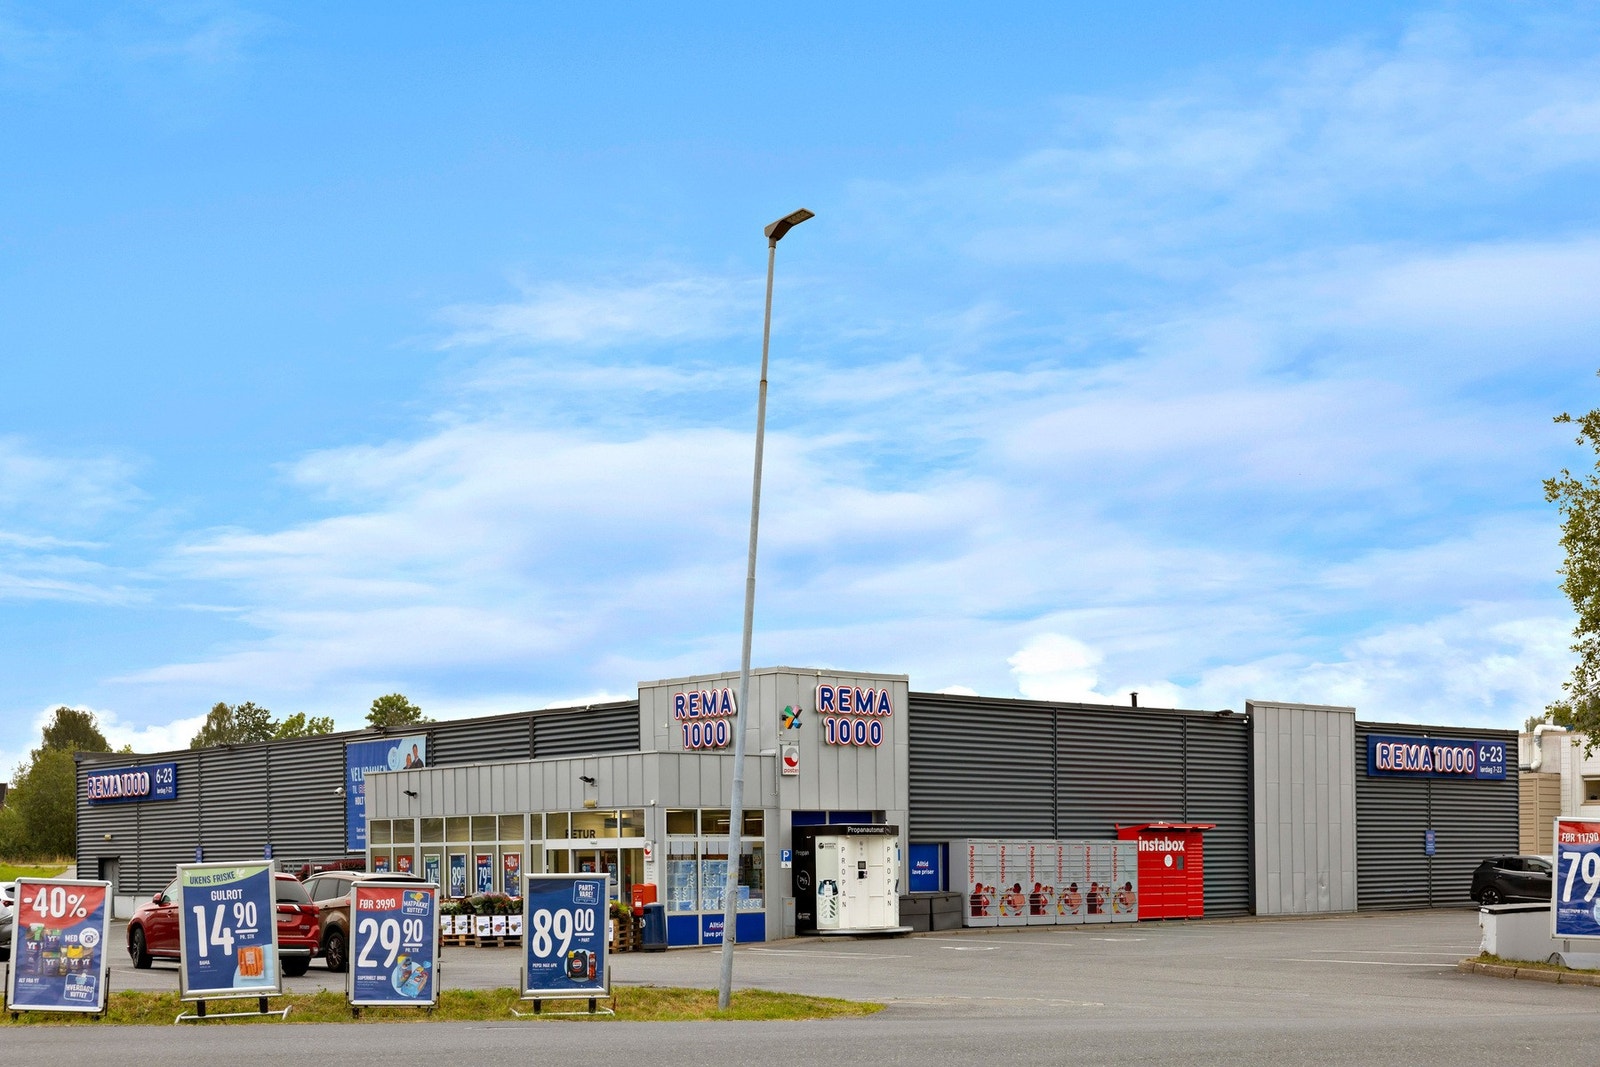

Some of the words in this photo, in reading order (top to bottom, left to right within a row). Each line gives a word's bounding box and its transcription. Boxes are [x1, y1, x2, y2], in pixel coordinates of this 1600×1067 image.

[674, 688, 735, 720] REMA
[817, 684, 893, 717] REMA
[682, 718, 730, 750] 1000
[824, 716, 884, 747] 1000
[1376, 742, 1433, 772] REMA
[1435, 745, 1475, 774] 1000
[1479, 746, 1503, 762] 6-23
[88, 775, 121, 799] REMA
[121, 772, 149, 796] 1000
[156, 768, 173, 783] 6-23
[848, 826, 885, 834] Propanautomat
[1561, 833, 1575, 842] FØR
[1577, 832, 1599, 843] 117,90
[1138, 836, 1185, 851] instabox
[783, 850, 790, 861] P
[190, 875, 211, 885] UKENS
[213, 871, 235, 883] FRISKE
[452, 866, 462, 886] 89
[479, 866, 487, 886] 79
[1562, 852, 1600, 903] 79
[23, 887, 87, 918] -40%
[210, 889, 243, 901] GULROT
[359, 899, 374, 909] FØR
[376, 898, 396, 911] 39,90
[193, 904, 235, 957] 14
[233, 901, 258, 928] 90
[532, 908, 573, 958] 89
[574, 908, 595, 932] 00
[357, 917, 401, 968] 29
[402, 918, 423, 943] 90
